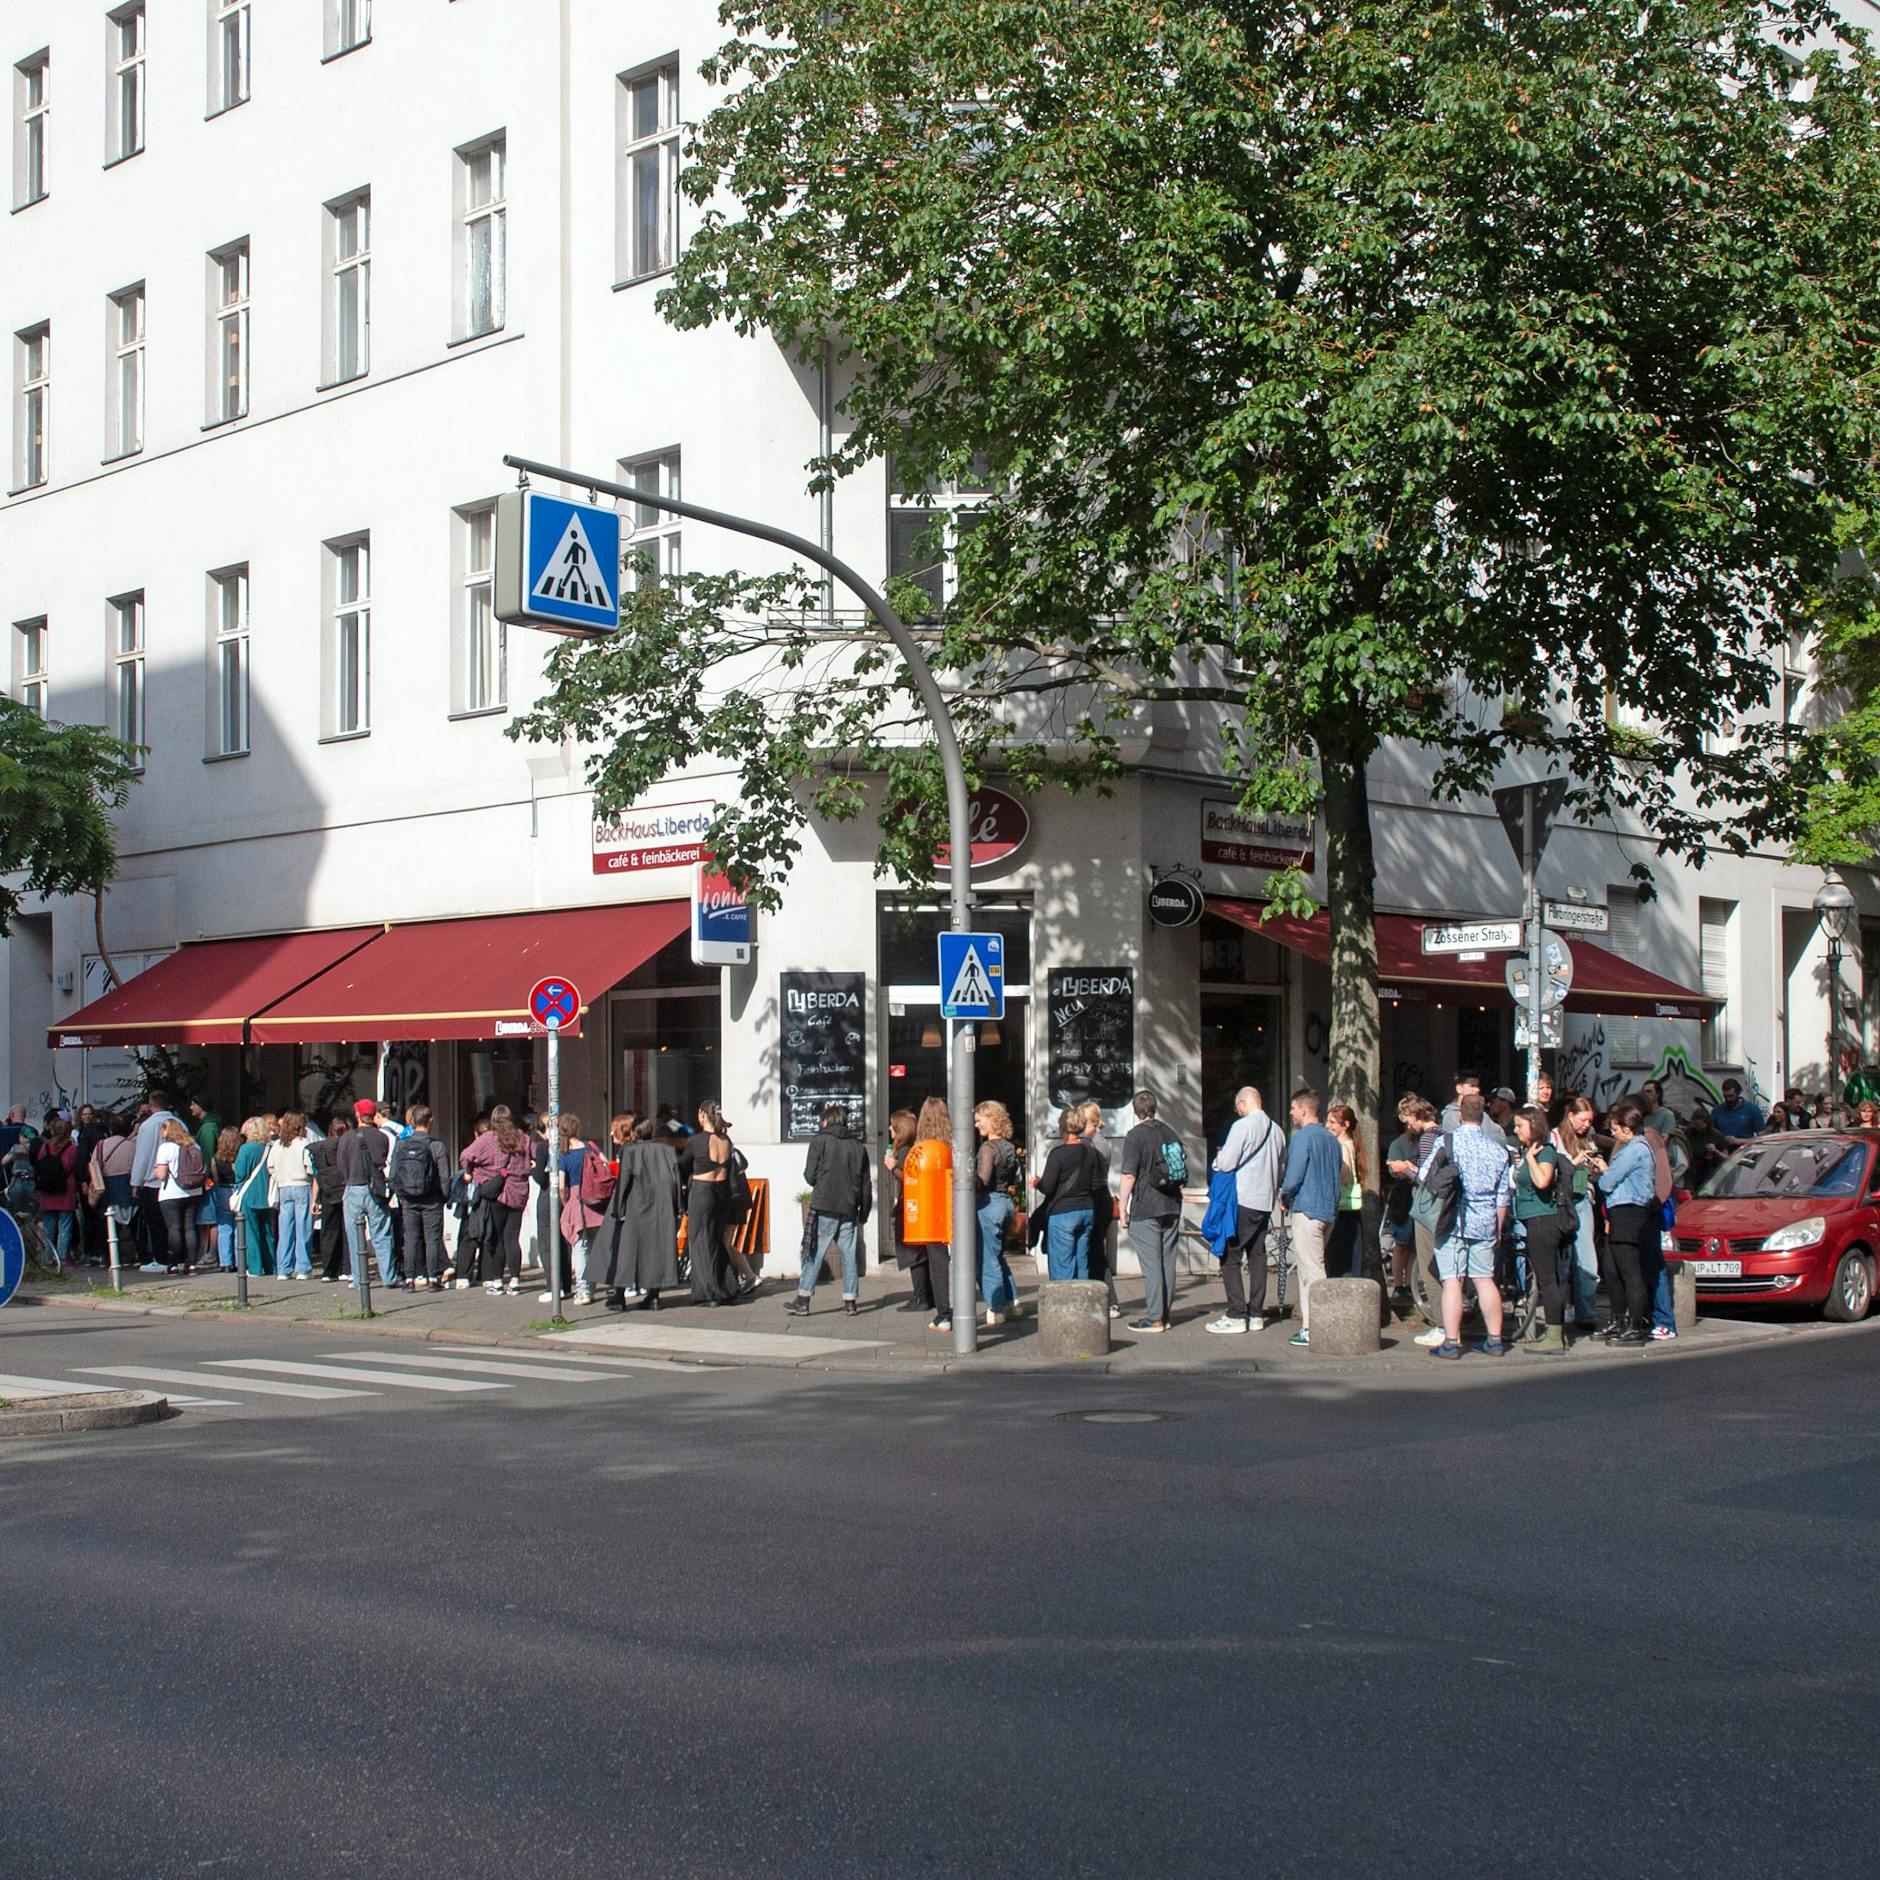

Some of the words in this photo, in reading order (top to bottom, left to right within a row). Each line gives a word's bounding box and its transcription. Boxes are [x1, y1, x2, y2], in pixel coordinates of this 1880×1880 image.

[608, 852, 628, 868] café
[631, 854, 639, 866] &
[642, 847, 700, 865] feinbäckerei
[1433, 928, 1480, 945] Zossener
